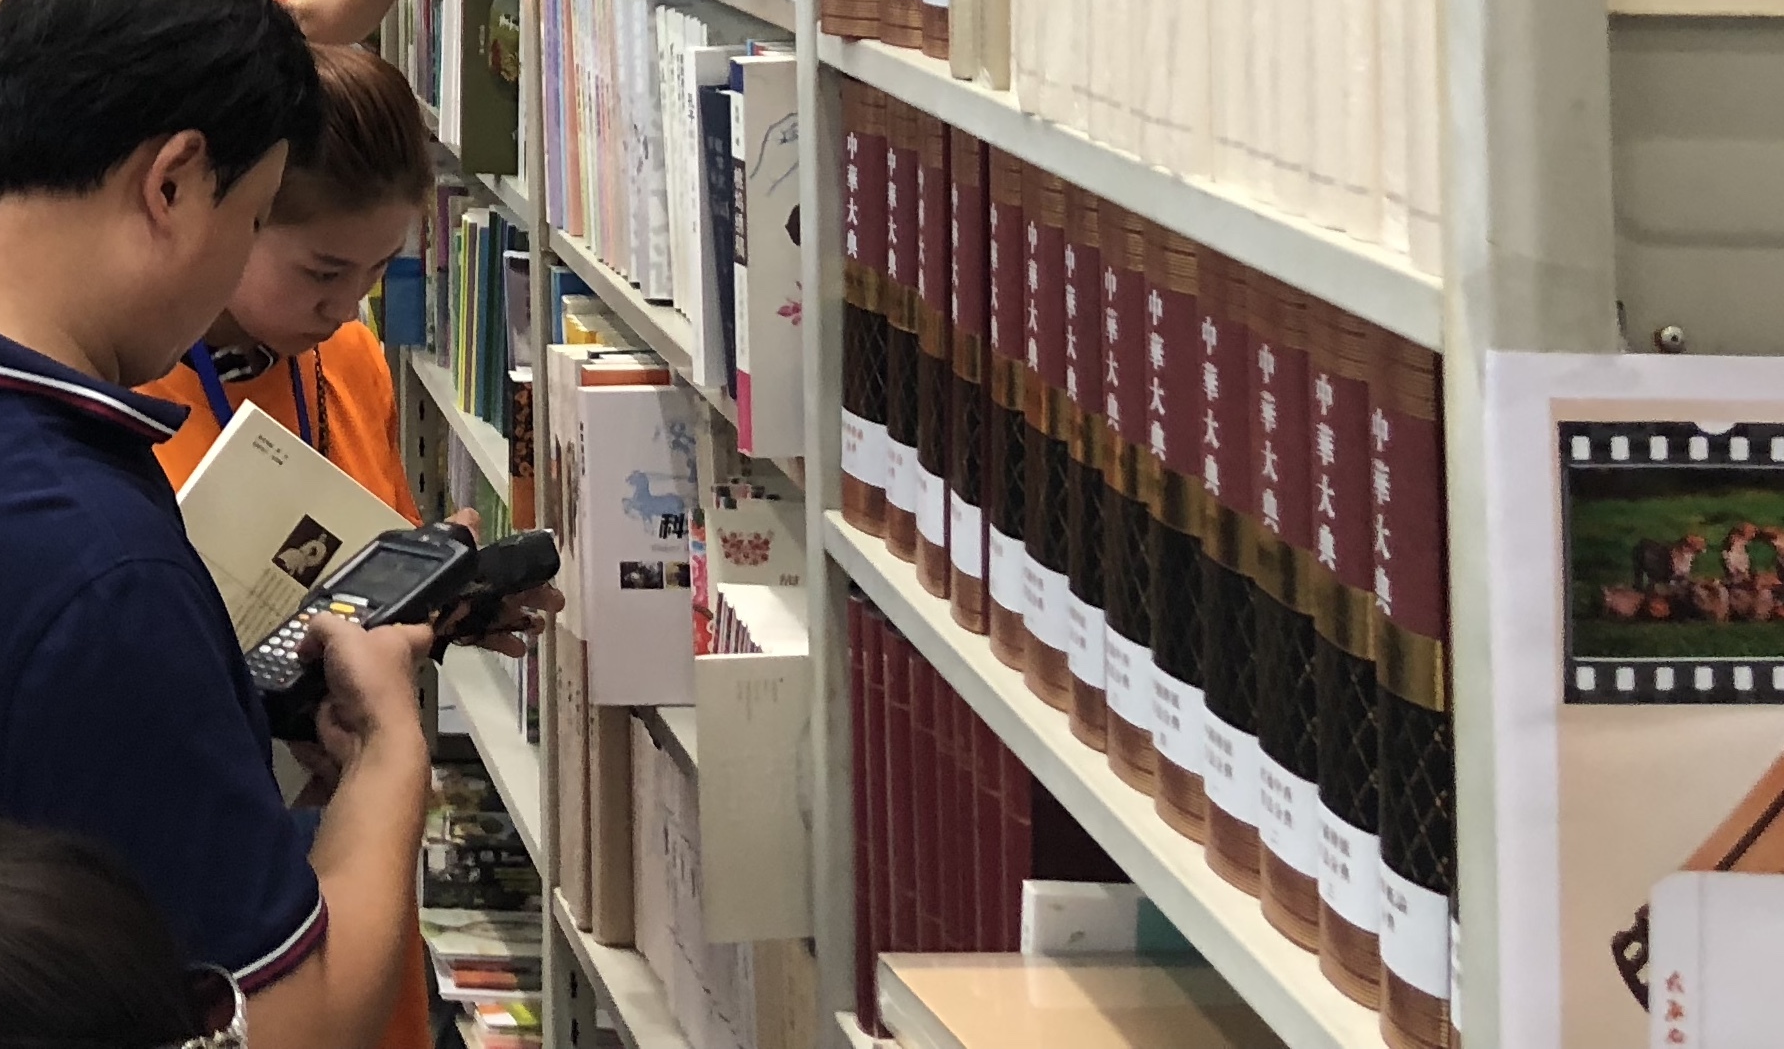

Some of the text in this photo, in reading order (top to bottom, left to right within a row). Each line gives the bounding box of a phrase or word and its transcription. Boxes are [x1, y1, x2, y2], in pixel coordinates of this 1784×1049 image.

[847, 131, 858, 259] 中華大典
[887, 147, 897, 279] 中華大典
[1028, 220, 1038, 372] 中華大典
[1065, 243, 1077, 402] 中華大典
[1104, 266, 1120, 432] 中華大典
[1148, 289, 1167, 461] 中華大典
[1201, 316, 1221, 496] 中華大典
[1258, 343, 1280, 534] 中華大典
[1316, 373, 1337, 571] 中華大典
[1371, 407, 1393, 616] 中華大典
